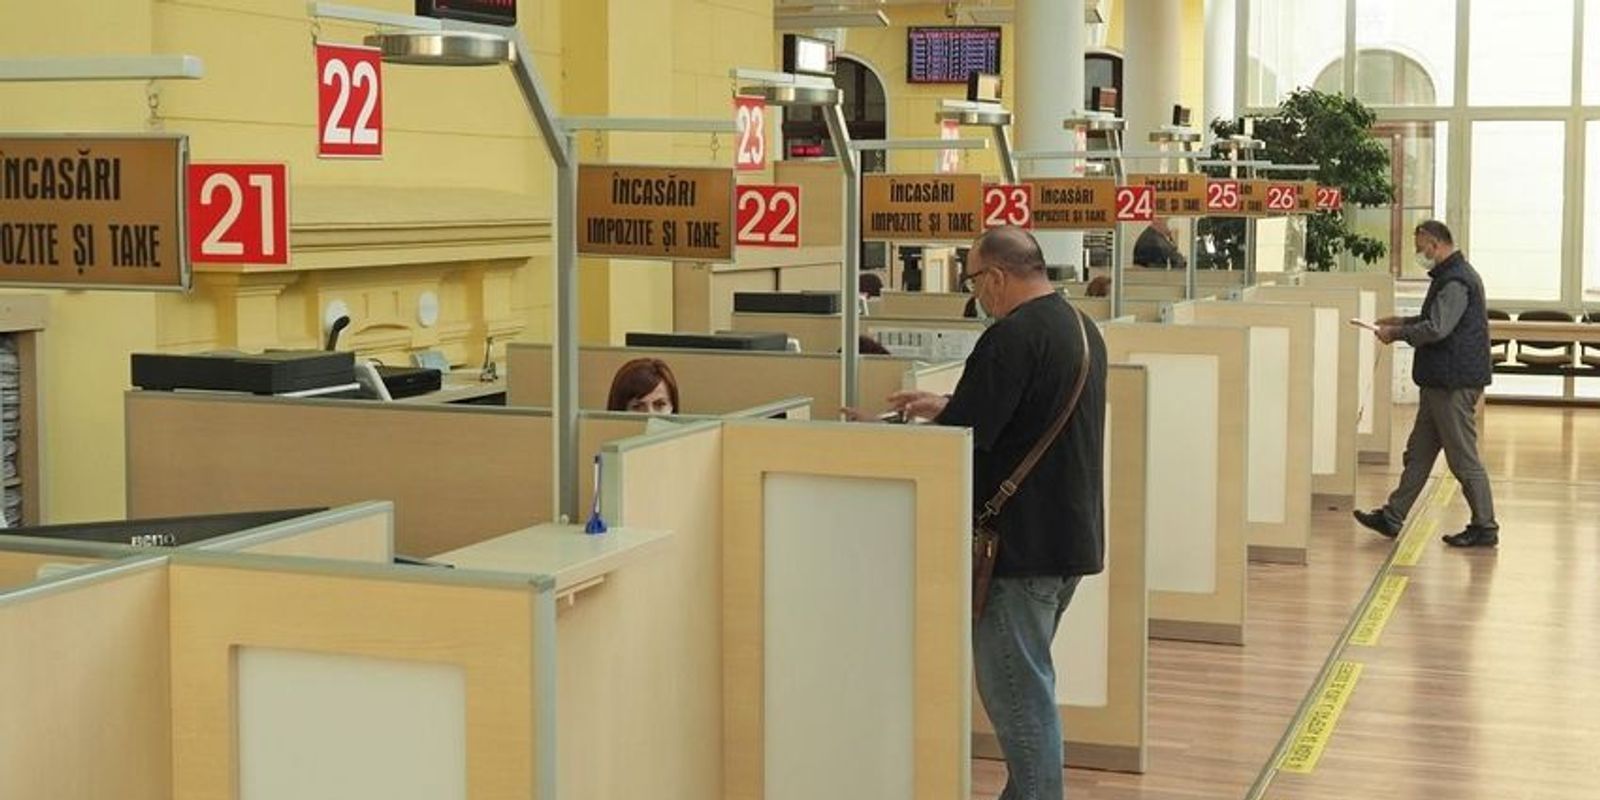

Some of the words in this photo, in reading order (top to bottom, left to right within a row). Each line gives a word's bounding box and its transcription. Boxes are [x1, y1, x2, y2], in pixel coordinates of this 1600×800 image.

[323, 58, 379, 145] 22
[736, 105, 765, 165] 23
[611, 172, 696, 207] ÎNCASĂRI
[889, 179, 955, 203] ÎNCASĂRI
[1116, 190, 1152, 219] 24
[1208, 183, 1238, 208] 25
[1269, 188, 1294, 209] 26
[1318, 189, 1339, 207] 27
[200, 173, 275, 256] 21
[738, 189, 797, 243] 22
[871, 212, 923, 232] IMPOZITE
[948, 213, 974, 233] TAXE
[985, 188, 1030, 226] 23
[73, 224, 95, 275] ȘI
[109, 224, 161, 268] TAXE
[587, 218, 654, 247] IMPOZITE
[662, 219, 677, 252] ȘI
[685, 221, 721, 249] TAXE
